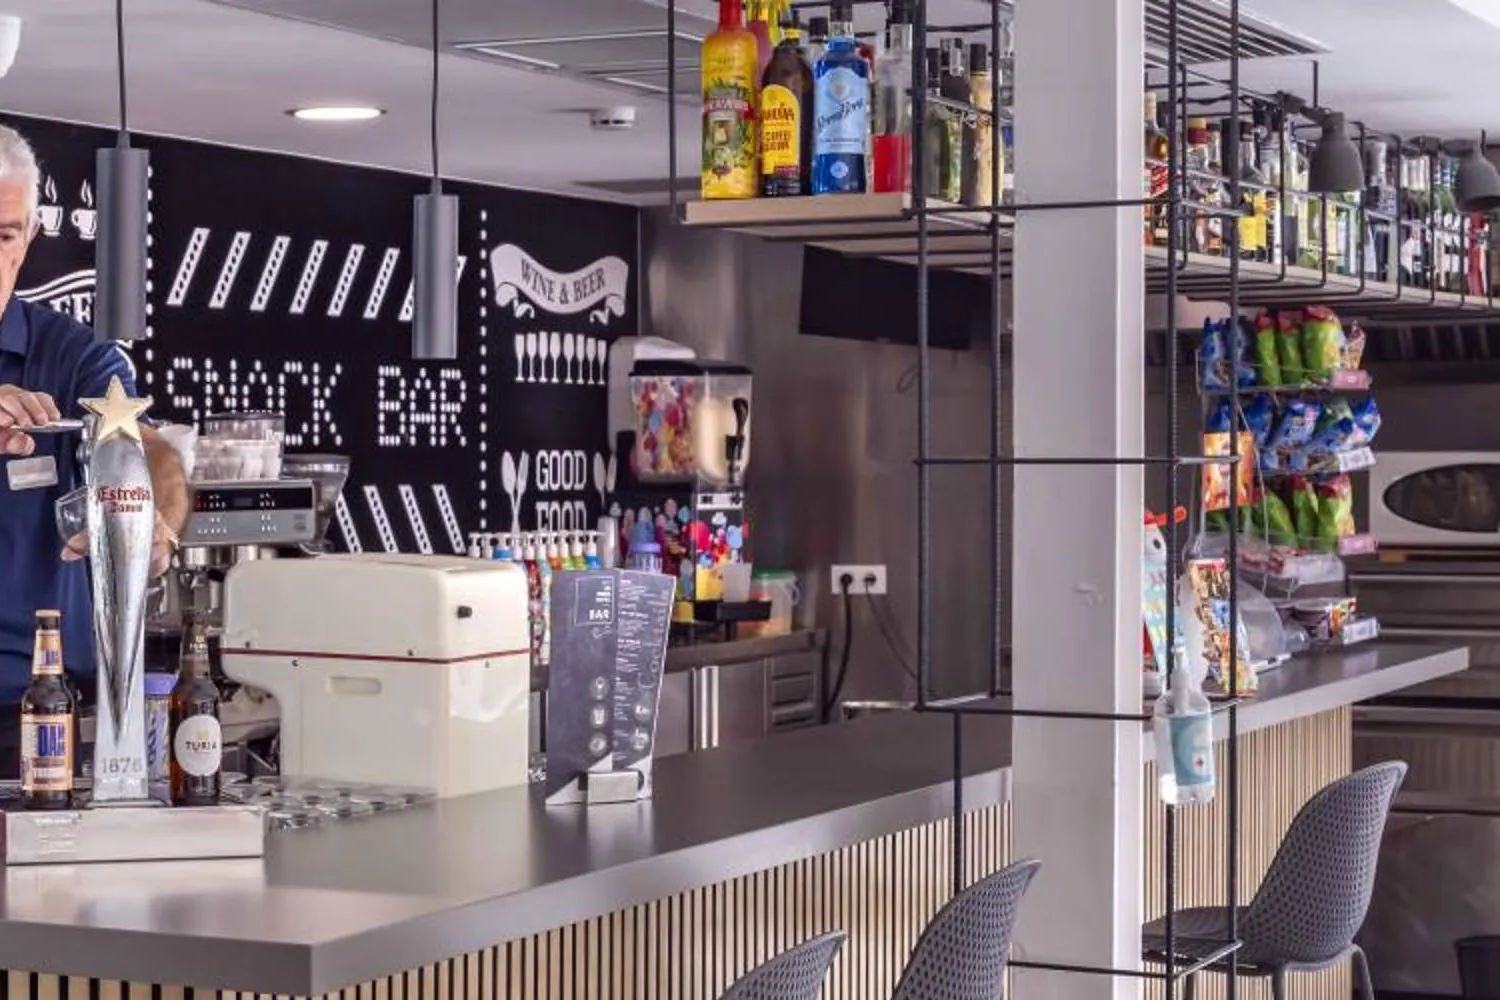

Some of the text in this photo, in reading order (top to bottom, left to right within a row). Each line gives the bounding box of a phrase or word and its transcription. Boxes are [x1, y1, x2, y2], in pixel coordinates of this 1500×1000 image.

[521, 258, 606, 306] WINE & BEER
[166, 357, 467, 447] SNACK BAR
[535, 450, 587, 491] GOOD
[536, 501, 587, 531] FOOD
[102, 756, 142, 774] 1876
